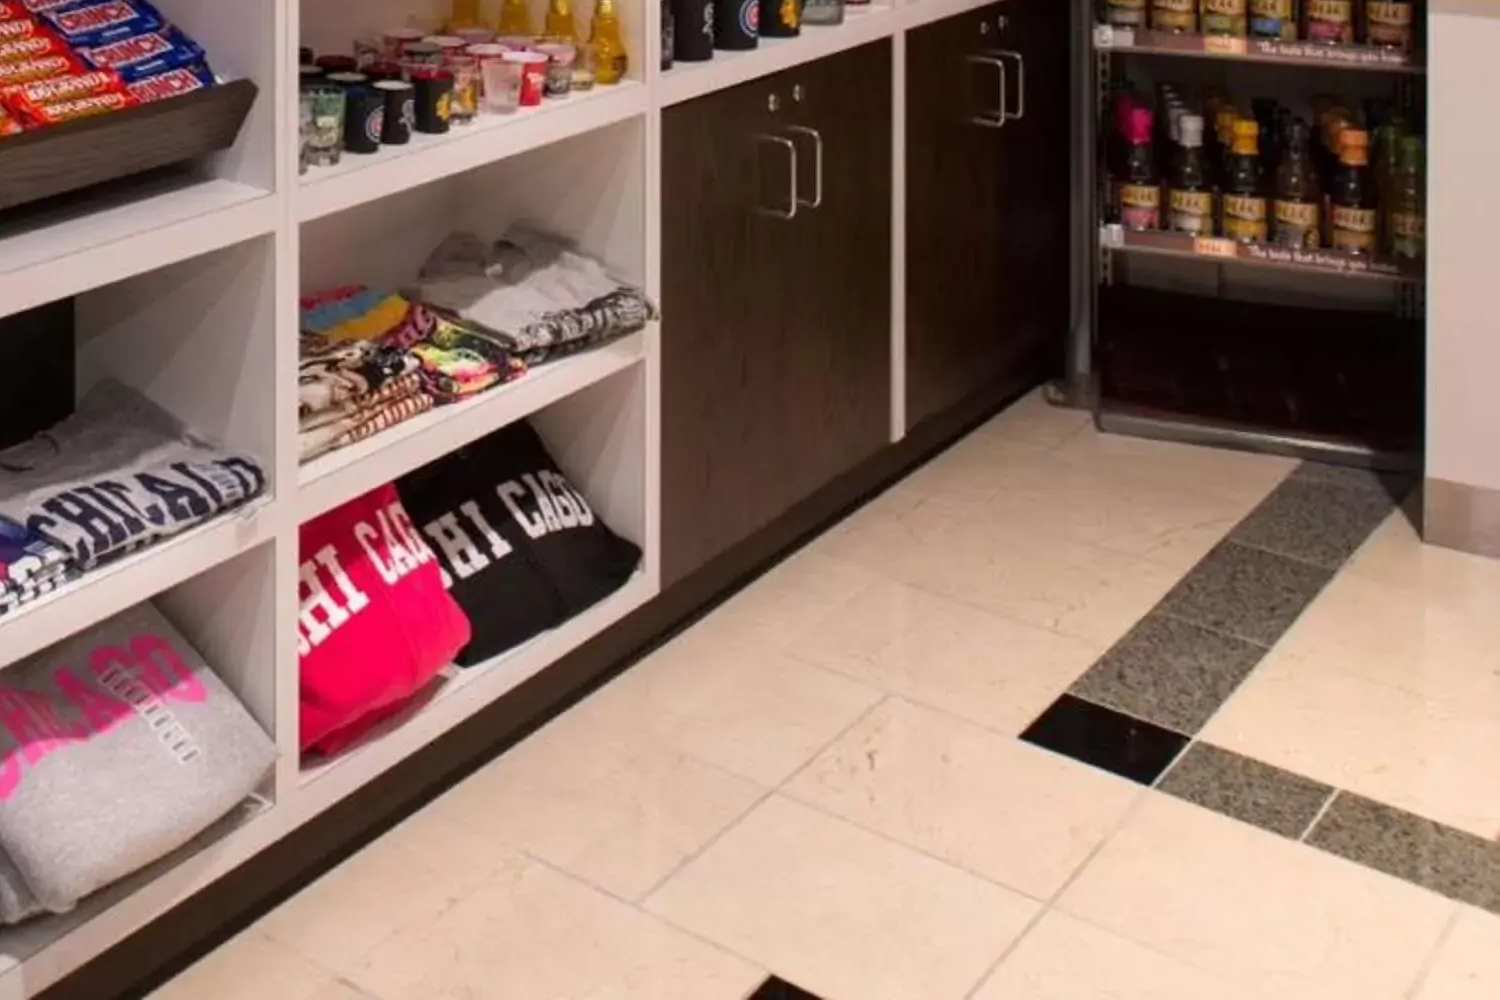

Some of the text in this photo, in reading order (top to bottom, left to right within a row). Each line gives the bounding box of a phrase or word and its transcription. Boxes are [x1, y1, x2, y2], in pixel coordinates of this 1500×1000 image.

[422, 469, 595, 589] HI CAGO
[298, 544, 371, 658] HI
